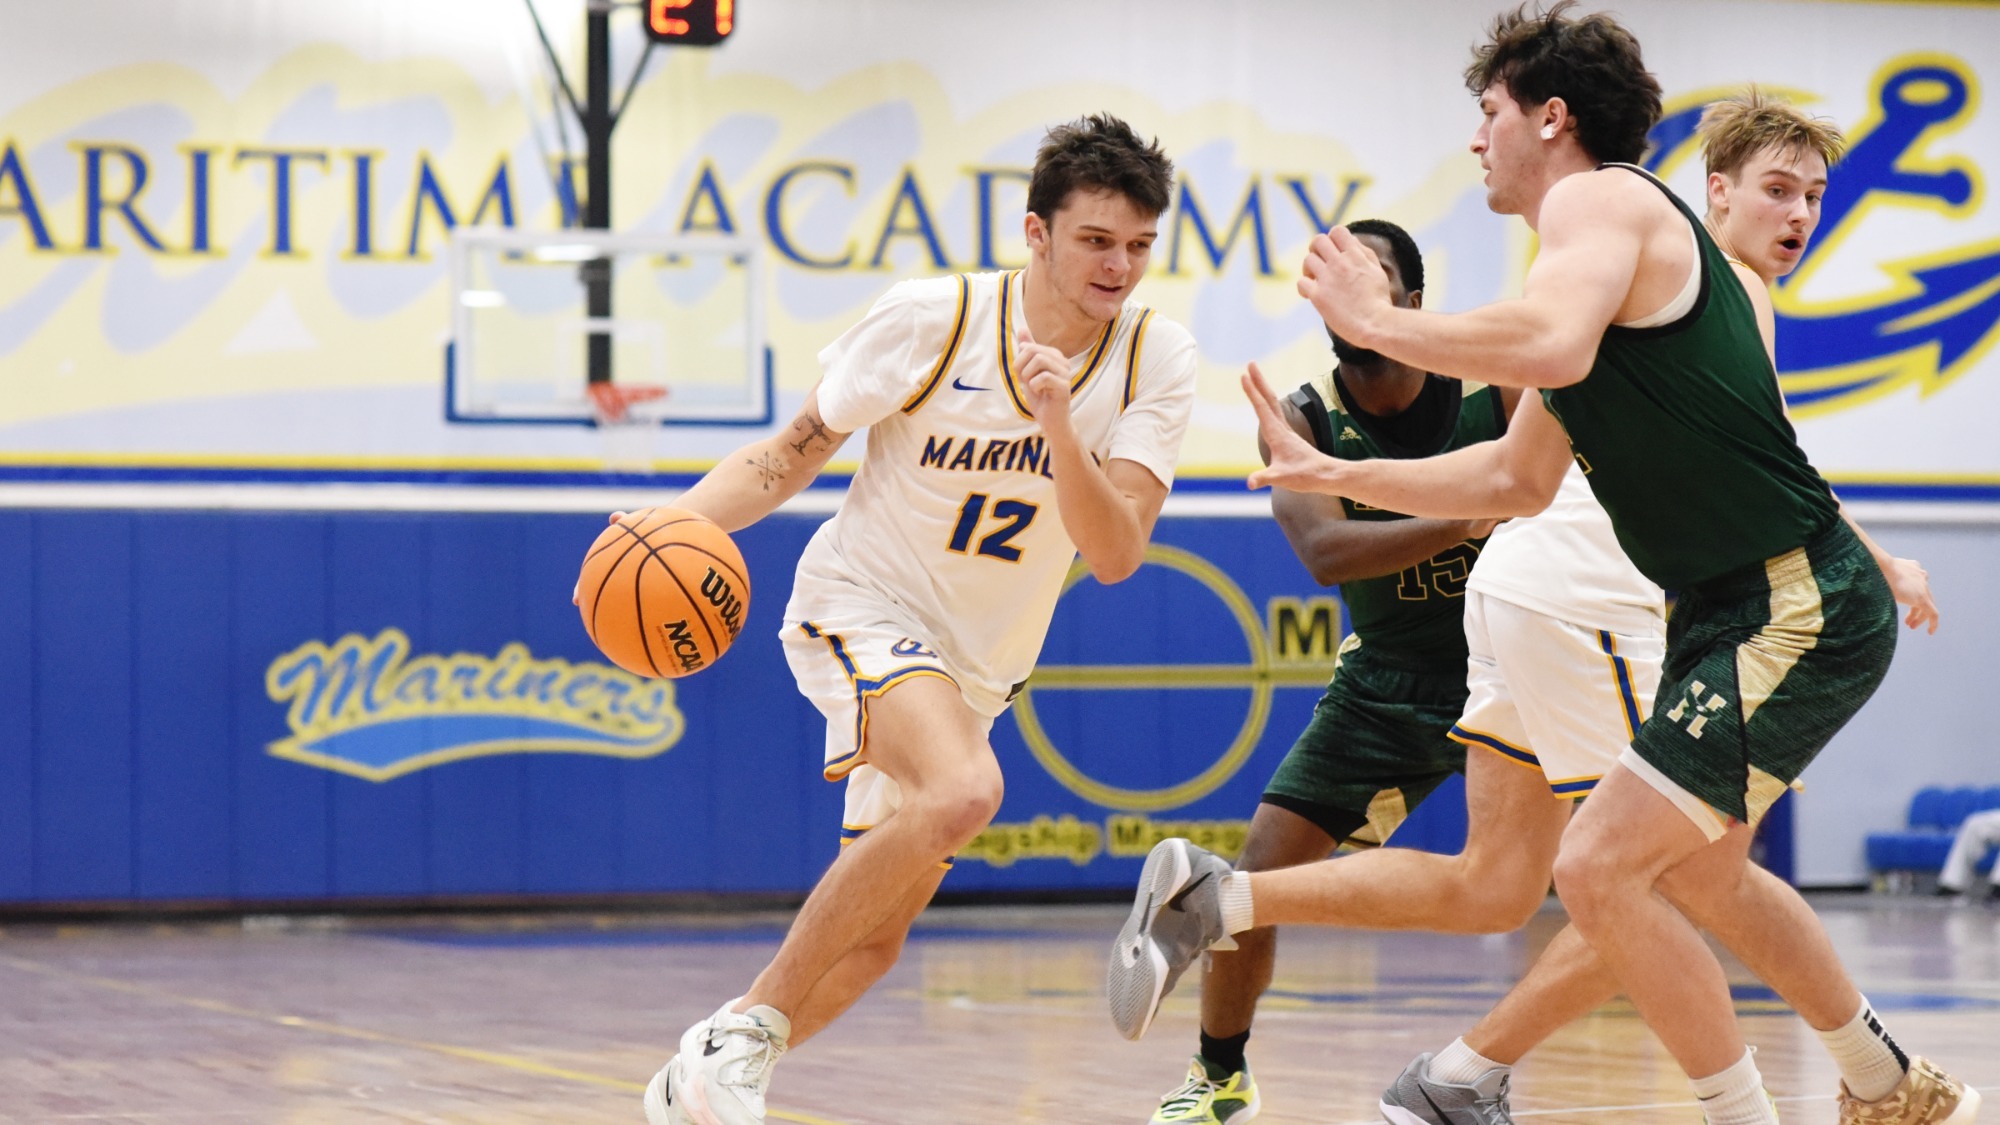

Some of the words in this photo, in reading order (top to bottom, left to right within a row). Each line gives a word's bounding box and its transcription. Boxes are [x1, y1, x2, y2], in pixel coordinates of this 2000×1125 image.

[651, 157, 1372, 281] ACADMY
[919, 434, 1101, 481] MARIN
[945, 491, 1041, 564] 12
[701, 566, 742, 642] Wilso
[1397, 541, 1481, 600] 15
[267, 630, 677, 728] Mariners
[663, 619, 705, 673] NCAA
